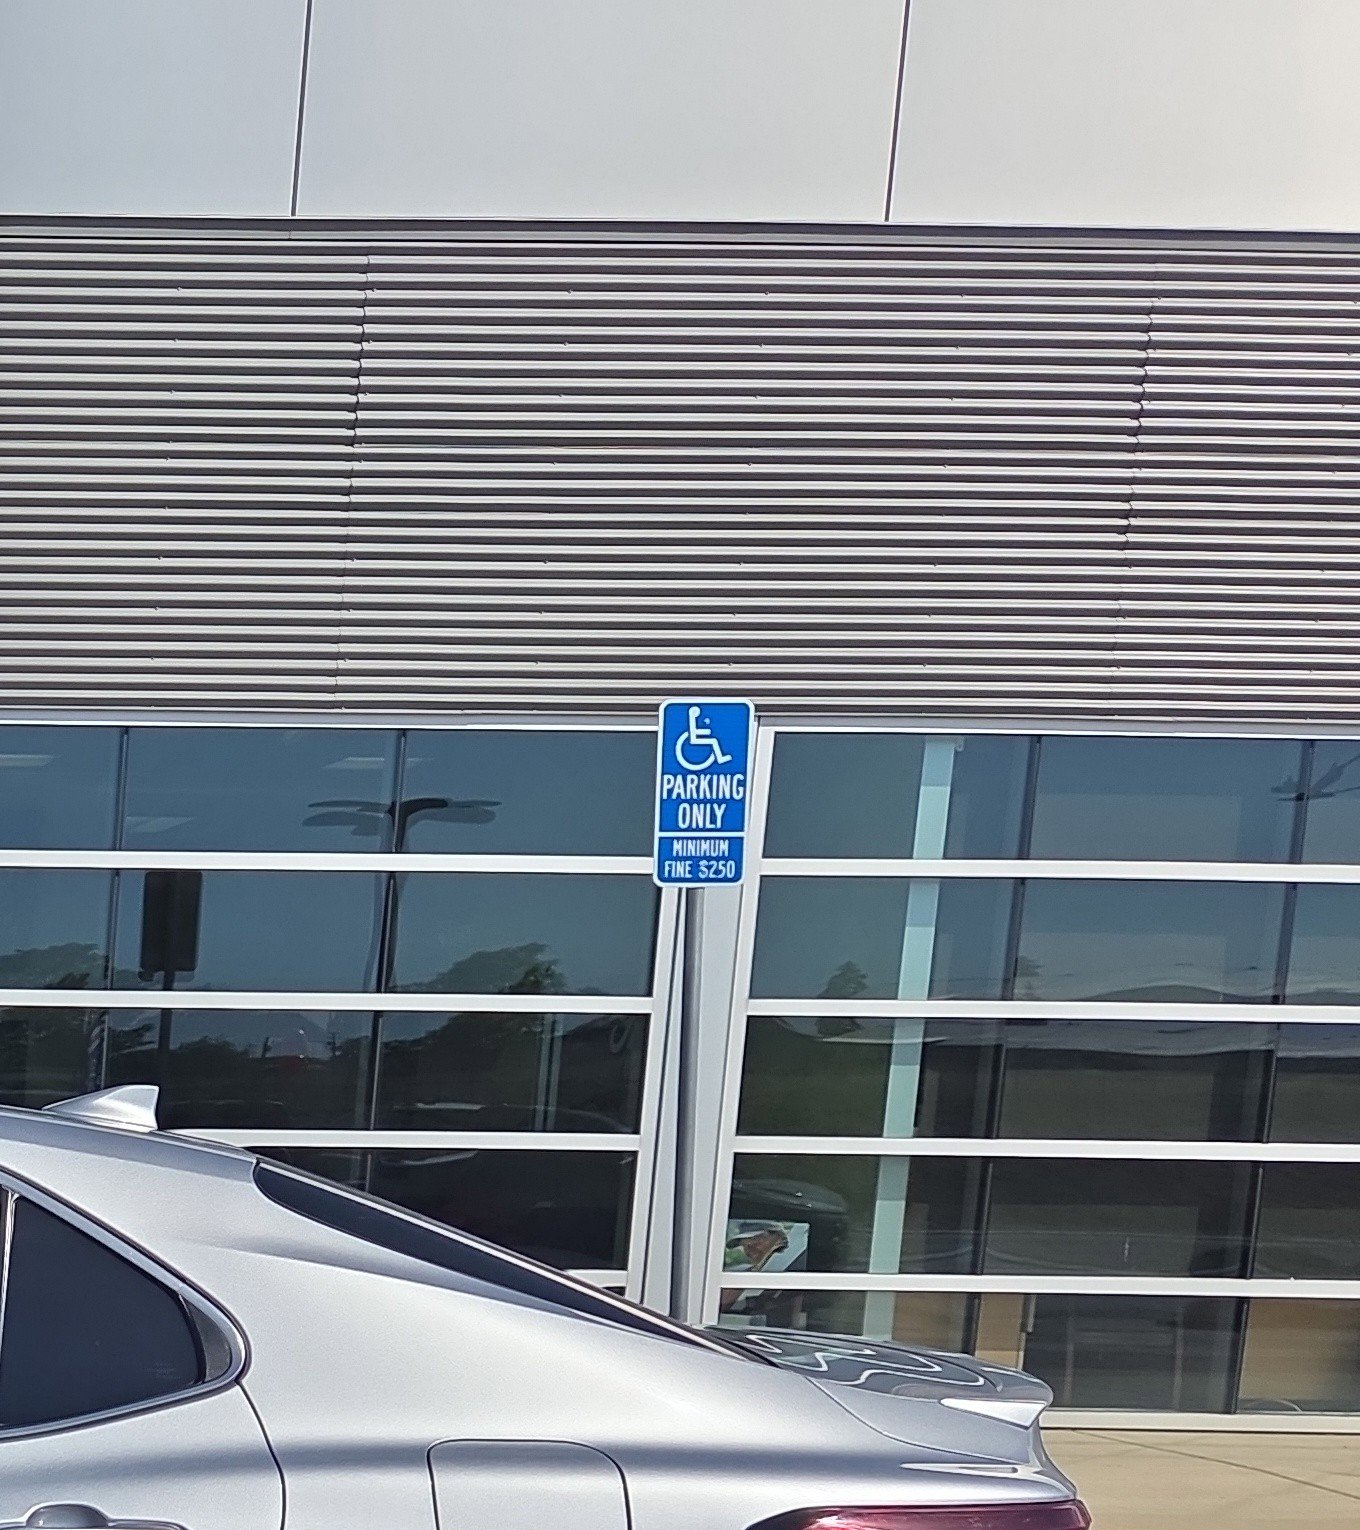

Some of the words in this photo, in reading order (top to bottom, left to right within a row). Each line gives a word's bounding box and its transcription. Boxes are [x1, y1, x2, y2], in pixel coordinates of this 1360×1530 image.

[662, 773, 745, 801] PARKING
[678, 802, 727, 829] ONLY
[672, 839, 730, 857] MINIMUM
[663, 860, 693, 878] FINE
[698, 859, 736, 879] $250
